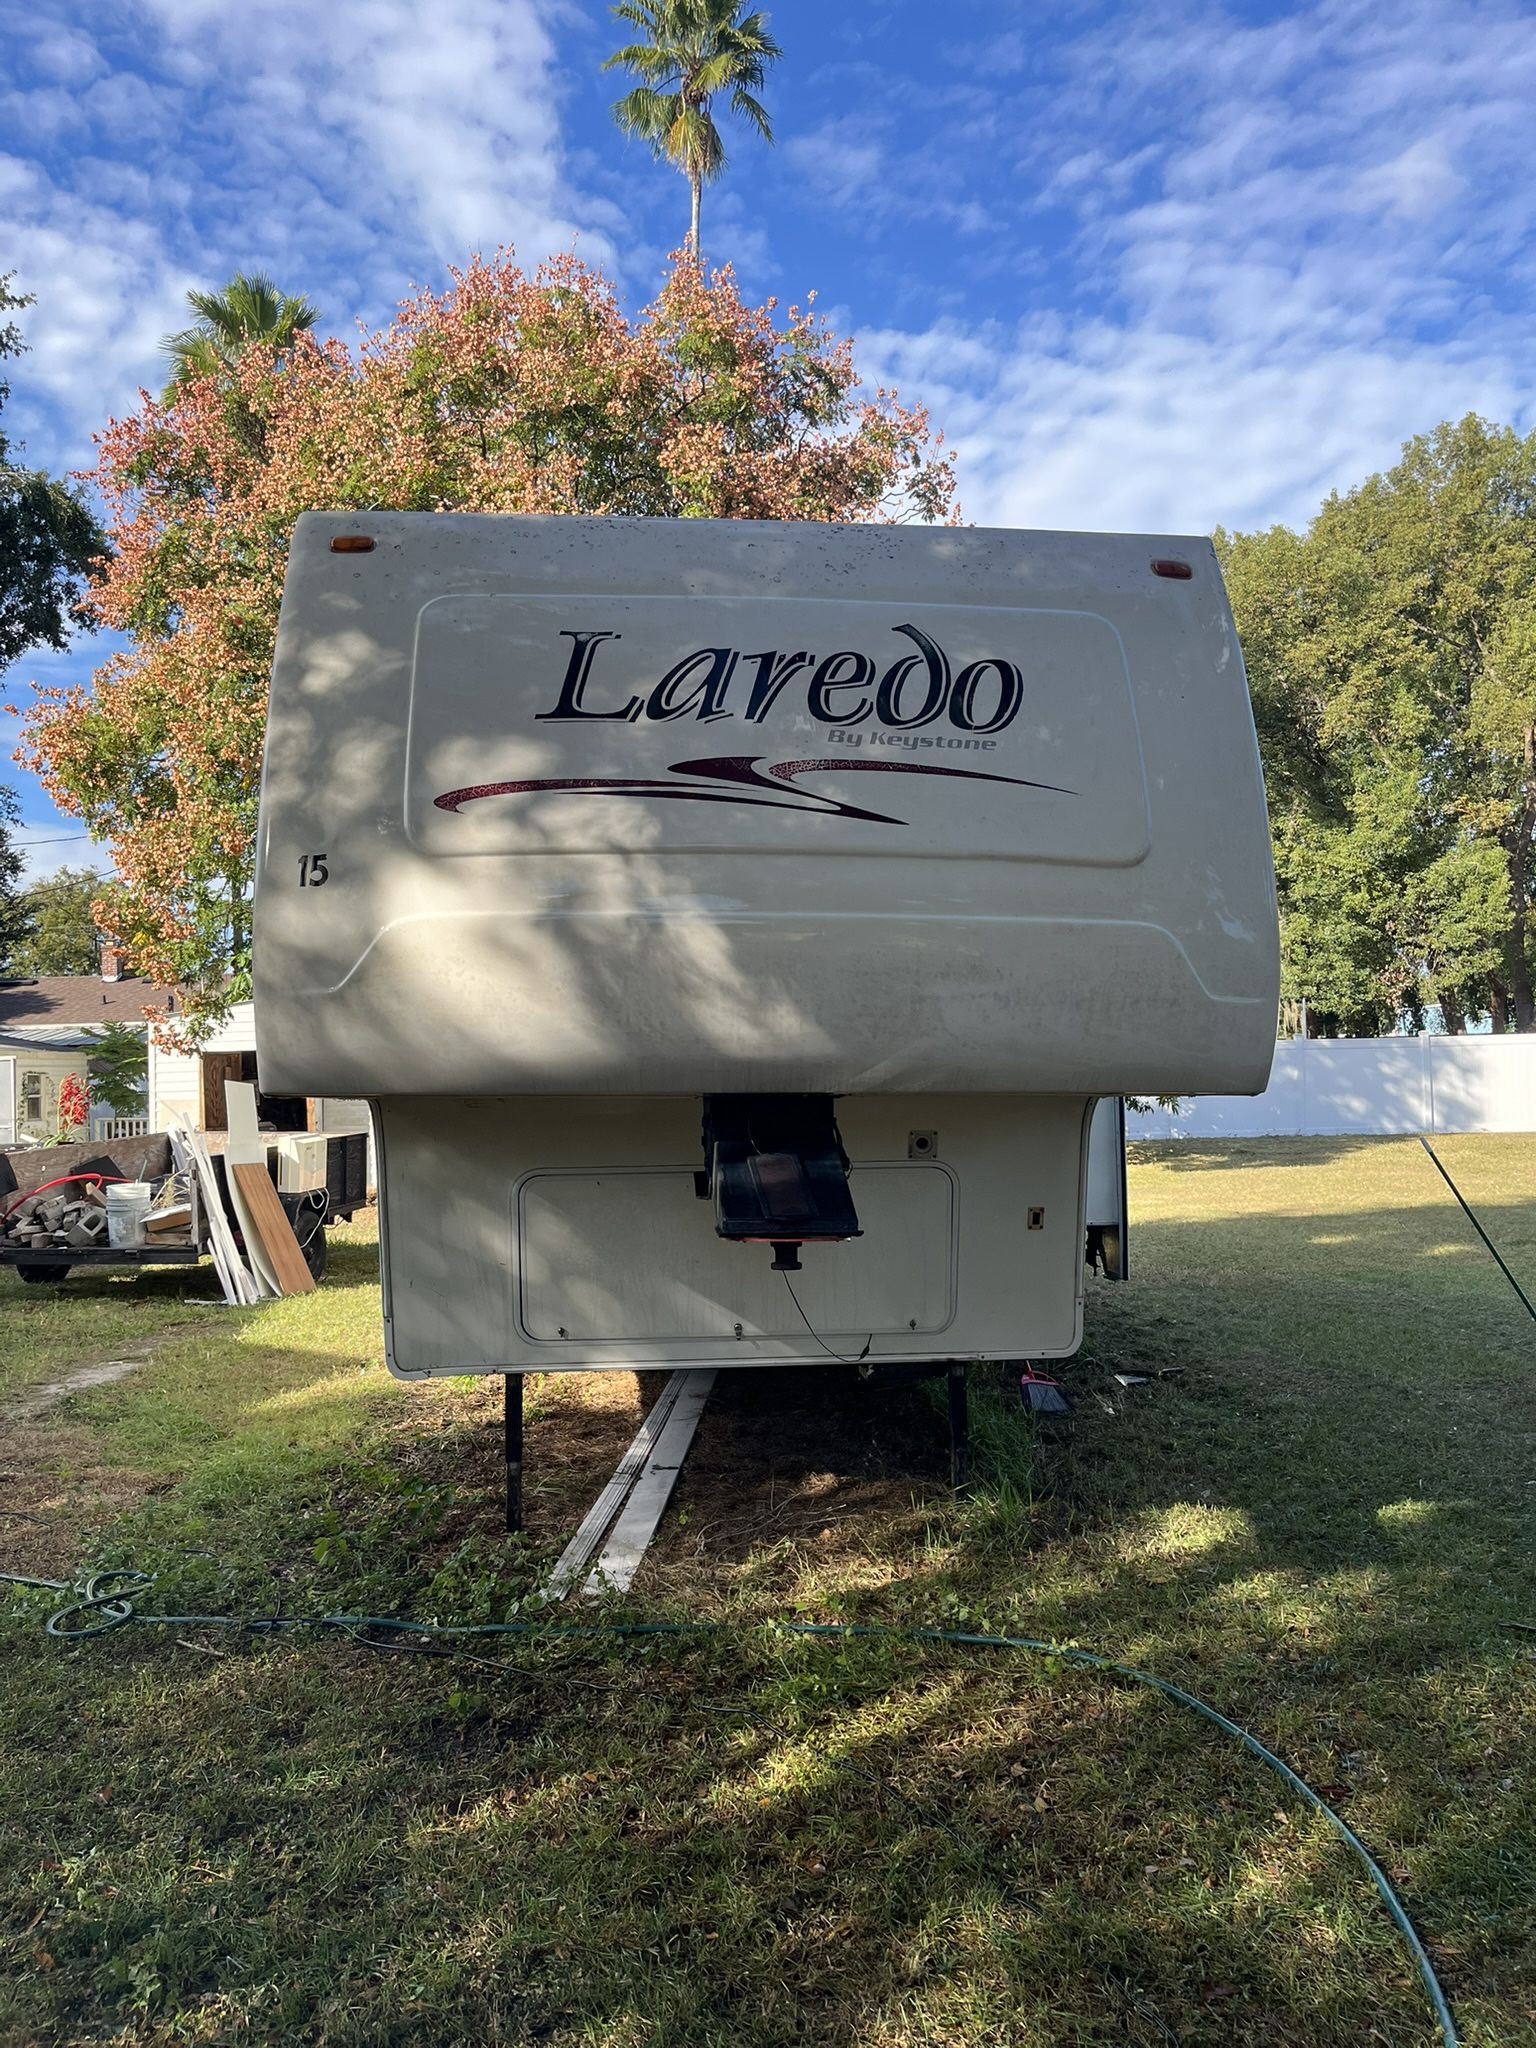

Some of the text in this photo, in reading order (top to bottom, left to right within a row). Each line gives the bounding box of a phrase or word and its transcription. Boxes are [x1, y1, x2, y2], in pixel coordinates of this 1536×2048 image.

[535, 624, 1024, 734] Laredo
[827, 729, 997, 750] By Keystone
[298, 853, 329, 887] 15
